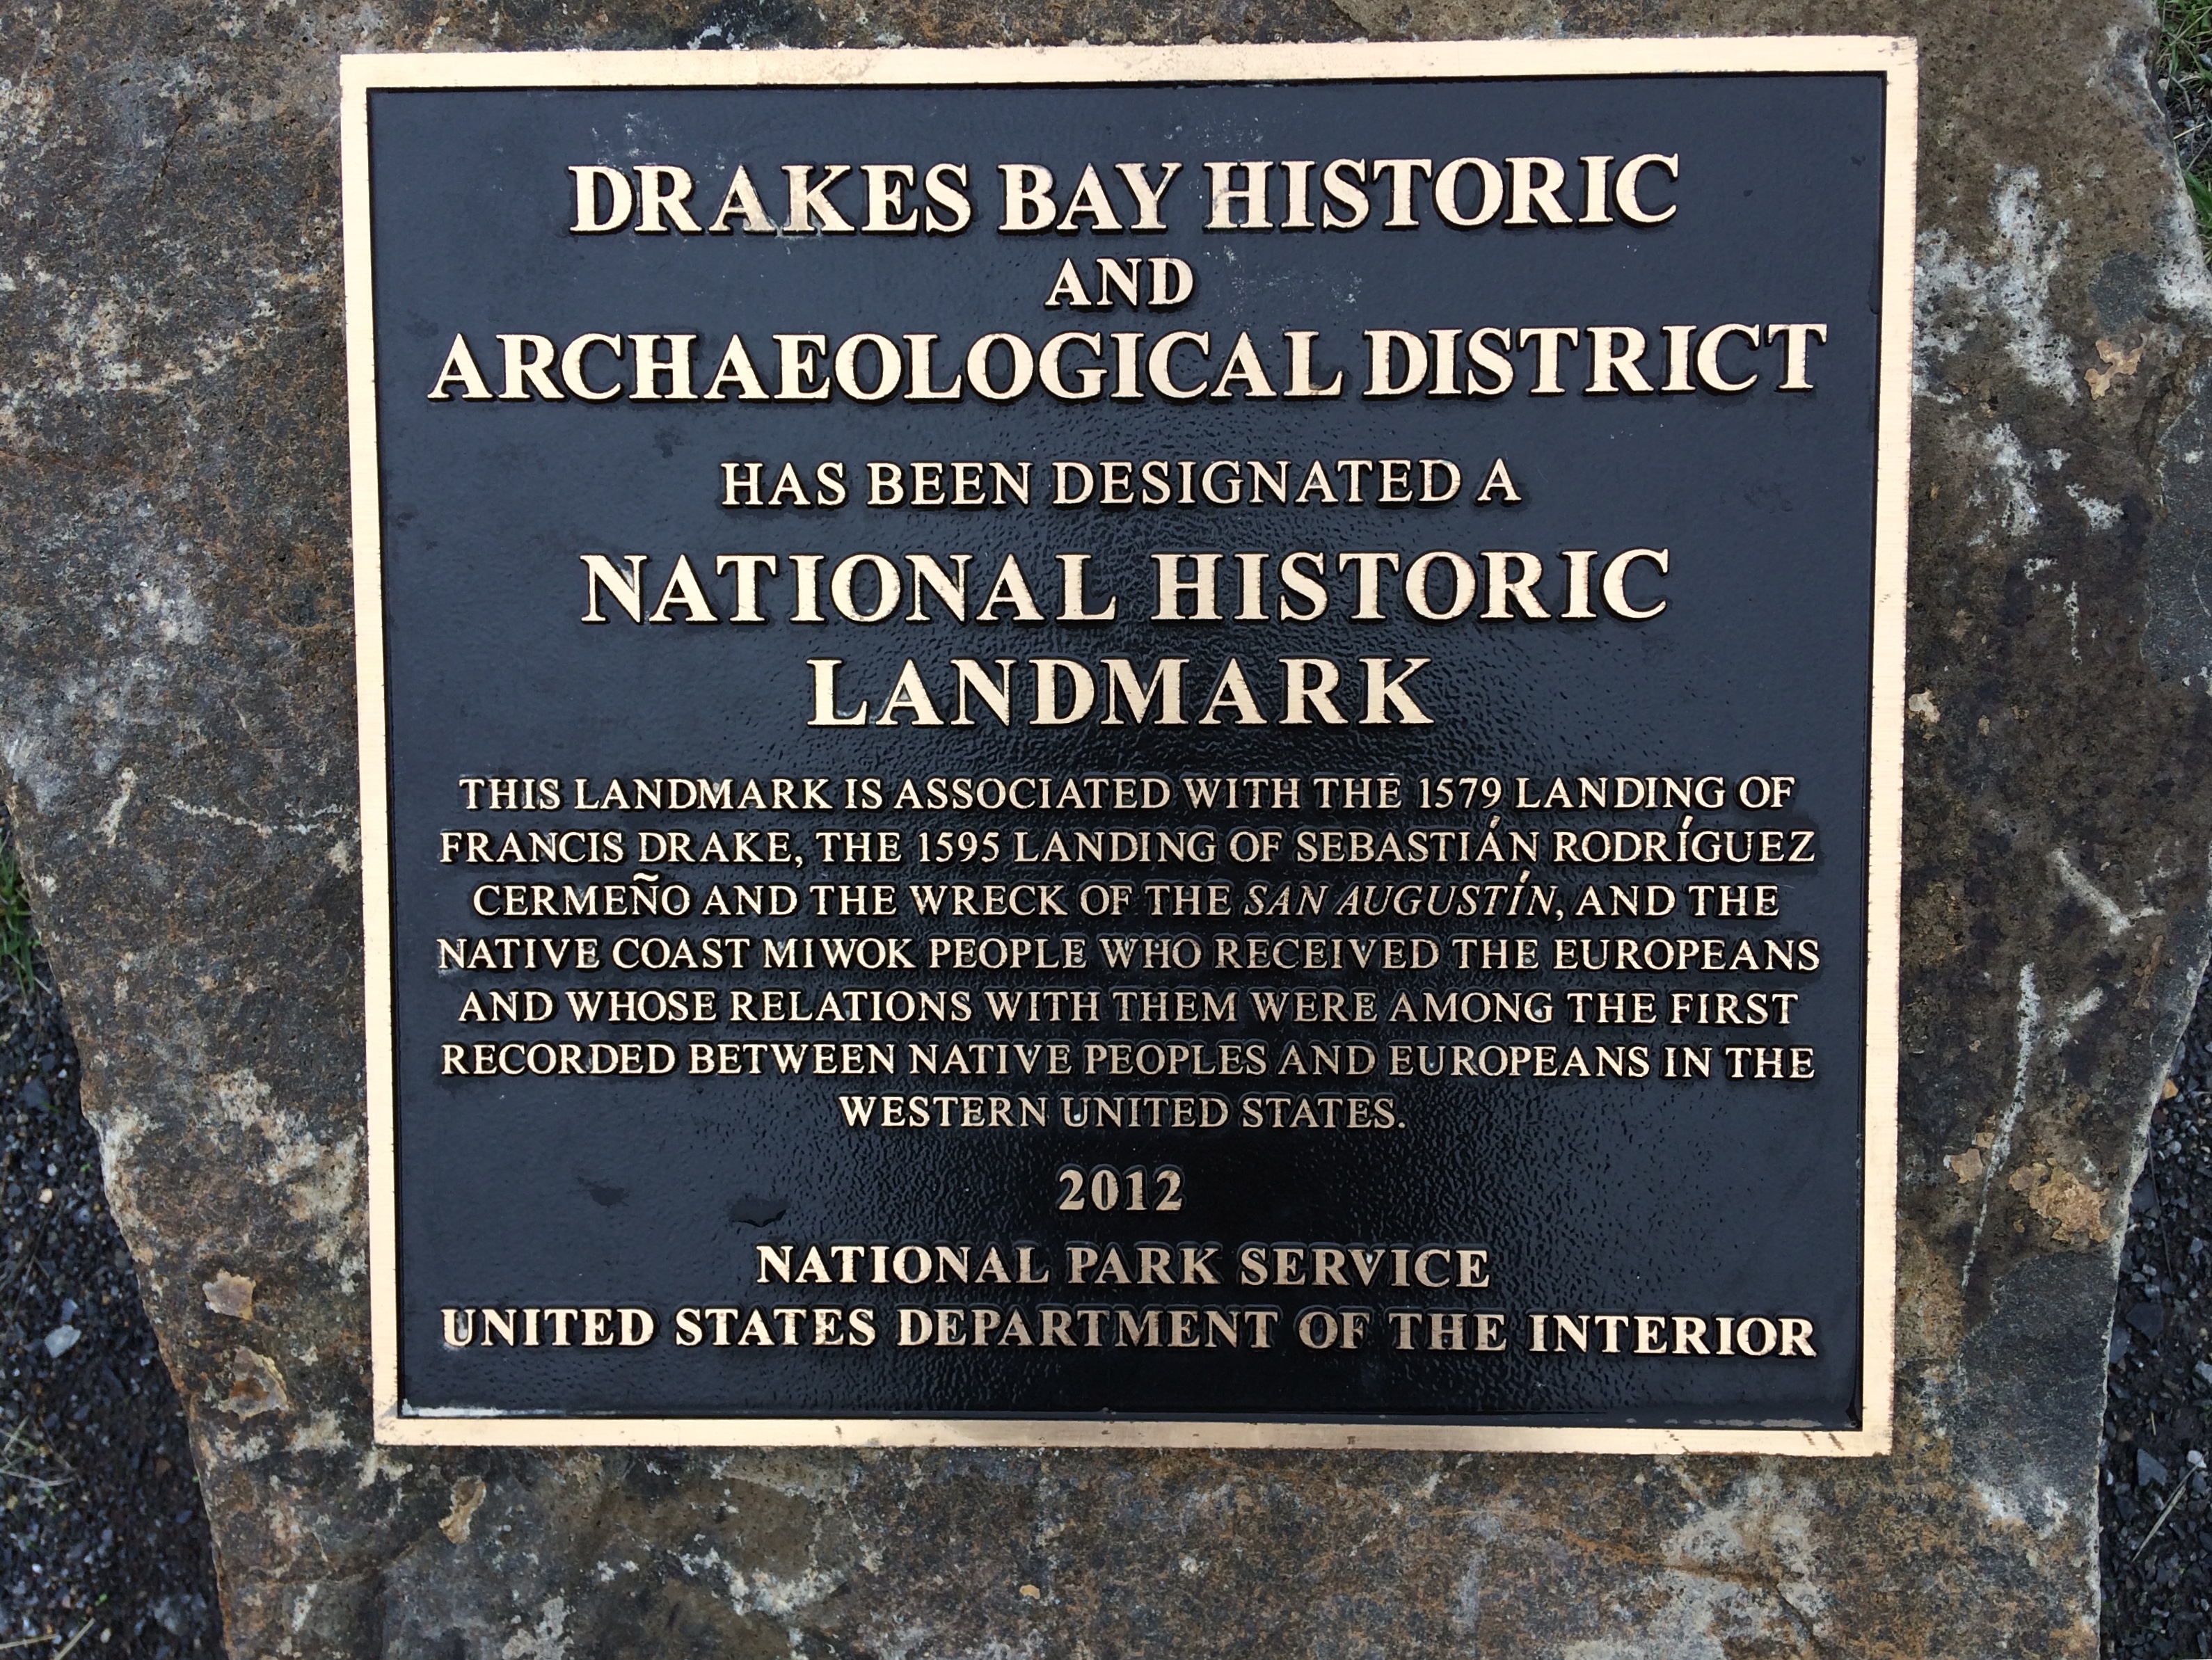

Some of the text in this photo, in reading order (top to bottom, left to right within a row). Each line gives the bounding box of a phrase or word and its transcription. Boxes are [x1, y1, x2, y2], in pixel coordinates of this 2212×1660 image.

[569, 154, 1678, 232] DRAKES BAY HISTORIC
[1046, 257, 1193, 305] AND
[428, 324, 1827, 400] ARCHAEOLOGICAL DISTRICT
[722, 459, 1521, 505] HAS BEEN DESIGNATED A
[581, 549, 1668, 623] NATIONAL HISTORIC
[807, 658, 1433, 726] LANDMARK
[459, 776, 1795, 809] THIS LANDMARK IS ASSOCIATED WITH THE 1579 LANDING OF
[441, 815, 1814, 868] FRANCIS DRAKE, THE 1595 LANDING OF SEBASTIÁN RODRÍGUEZ
[474, 870, 1779, 920] CERMEÑO AND THE WRECK OF THE SAN AUGUSTÍN, AND THE
[438, 938, 1820, 971] NATIVE COAST MIWOK PEOPLE WHO RECEIVED THE EUROPEANS
[459, 991, 1798, 1024] AND WHOSE RELATIONS WITH THEM WERE AMONG THE FIRST
[443, 1044, 1814, 1078] RECORDED BETWEEN NATIVE PEOPLES AND EUROPEANS IN THE
[839, 1096, 1405, 1128] WESTERN UNITED STATES.
[1060, 1170, 1181, 1211] 2012
[756, 1246, 1489, 1287] NATIONAL PARK SERVICE
[443, 1308, 1816, 1356] UNITED STATES DEPARTMENT OF THE INTERIOR
